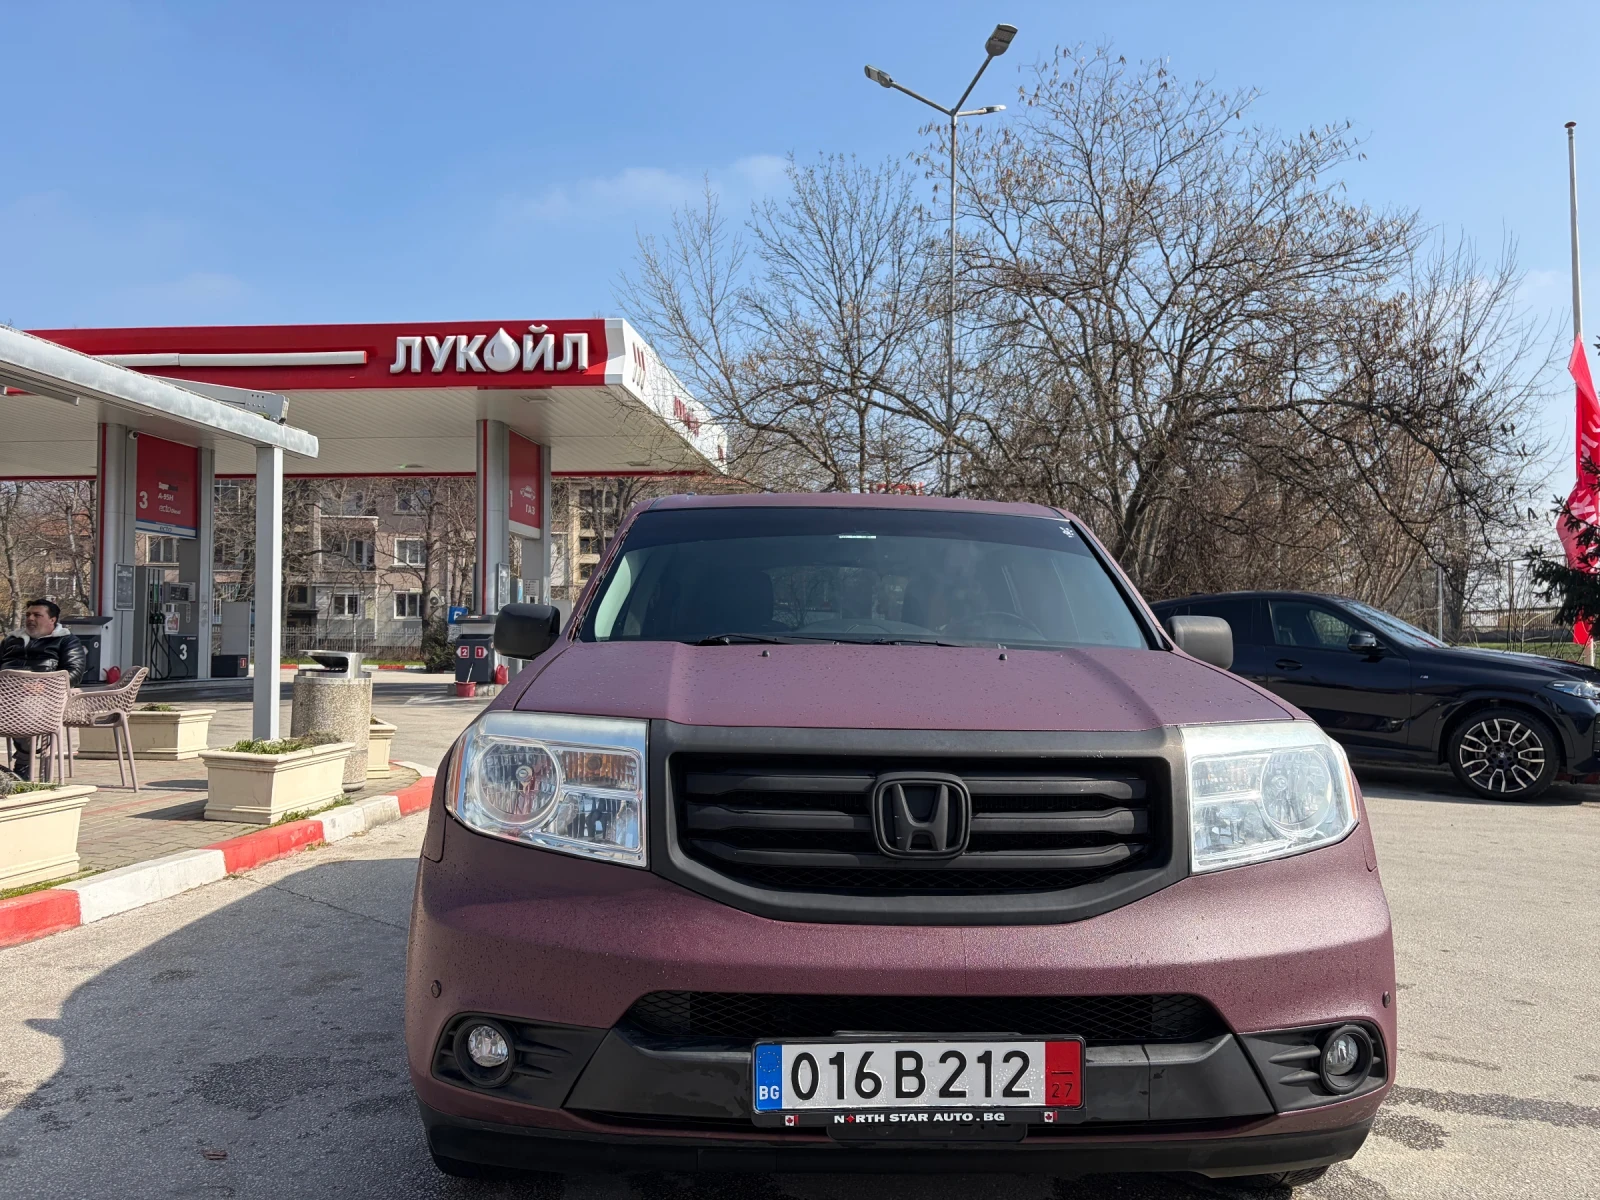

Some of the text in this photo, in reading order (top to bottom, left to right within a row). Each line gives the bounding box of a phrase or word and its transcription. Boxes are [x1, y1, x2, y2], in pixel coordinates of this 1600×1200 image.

[390, 324, 589, 374] ЛУКОЙЛ
[139, 490, 148, 509] 3
[525, 503, 536, 516] ГАЗ
[180, 644, 187, 660] 3
[759, 1085, 780, 1100] BG
[1051, 1083, 1074, 1098] 27
[889, 1112, 929, 1122] STAR
